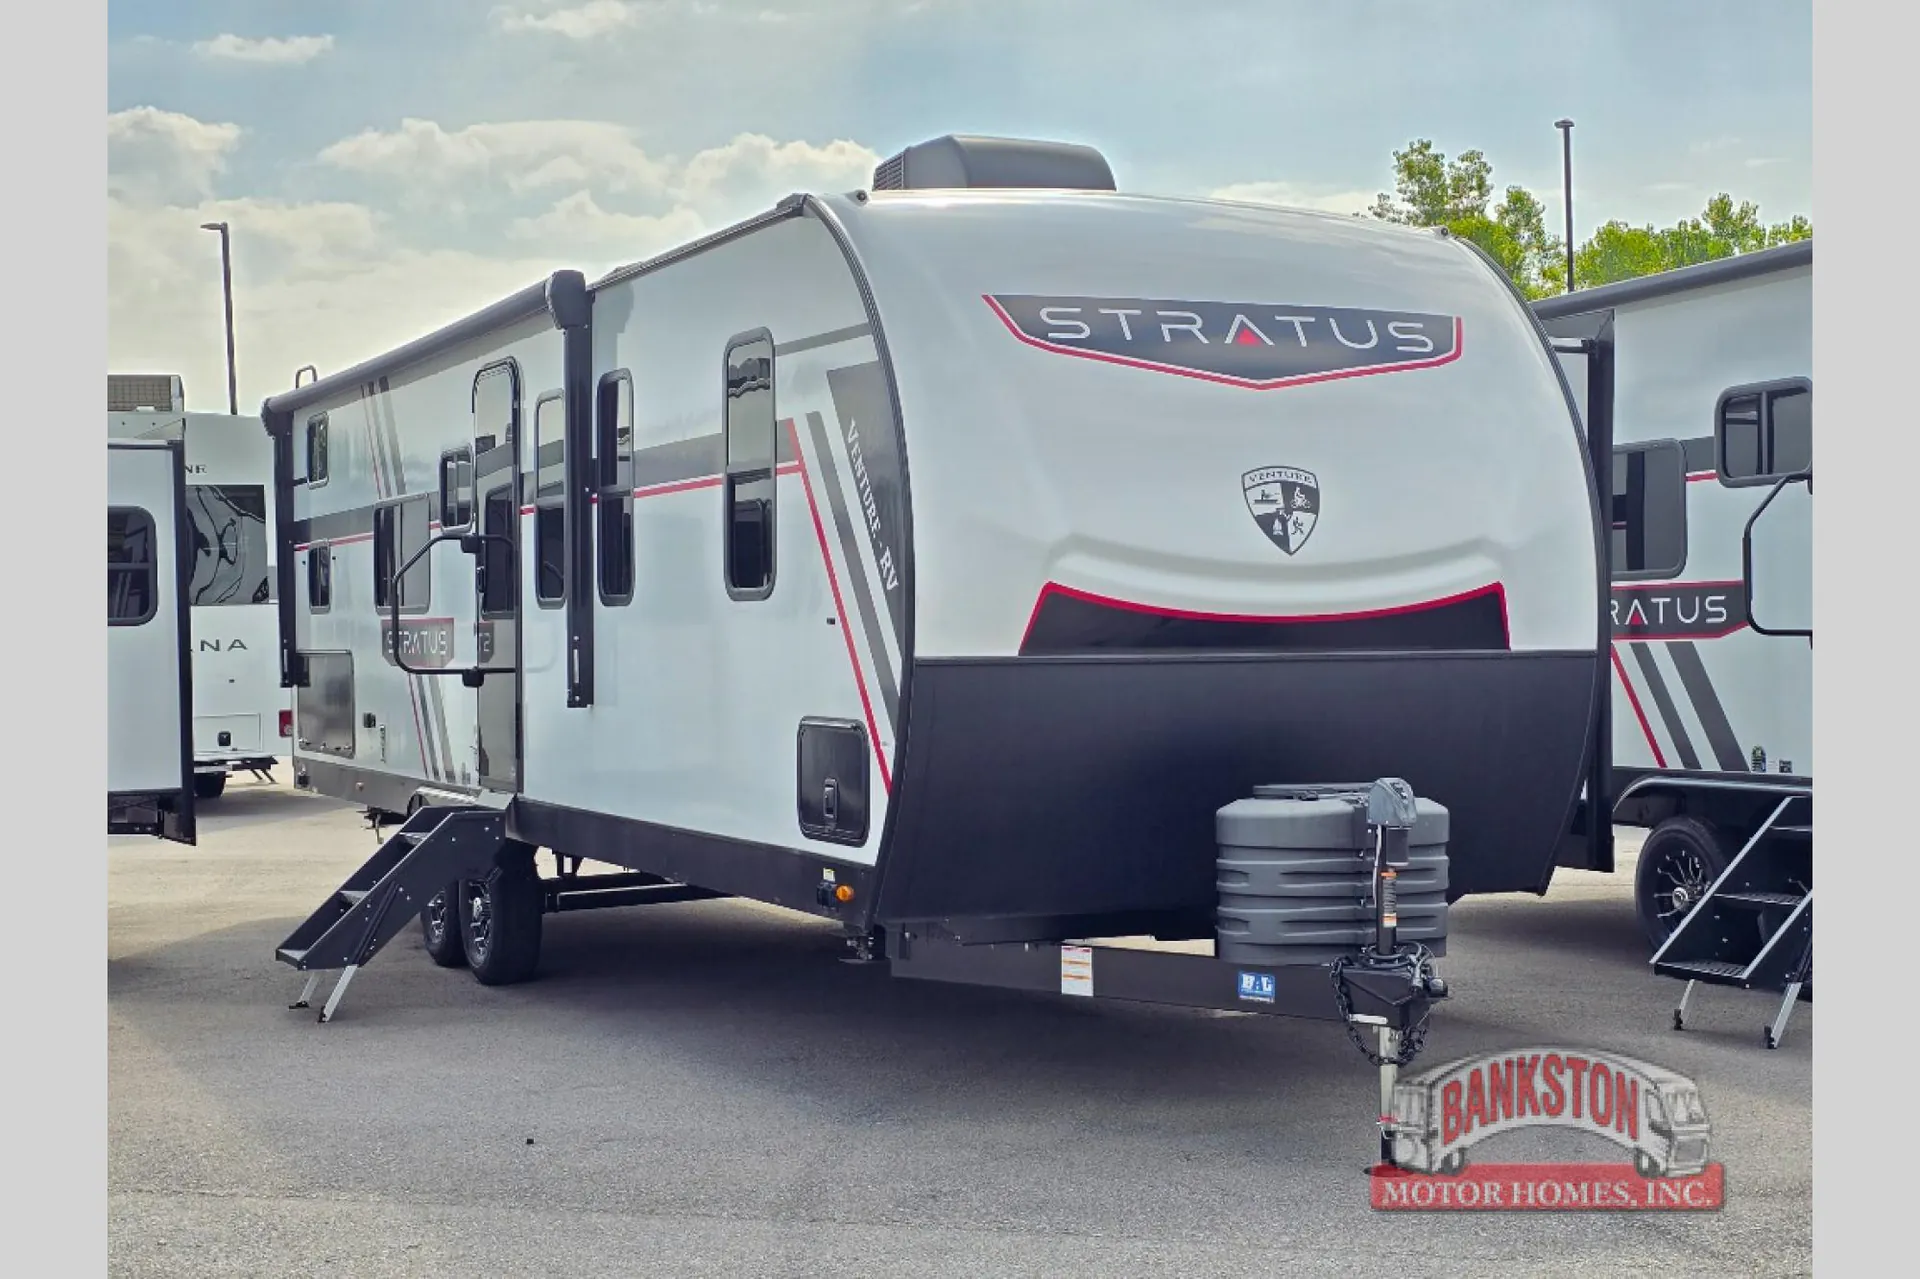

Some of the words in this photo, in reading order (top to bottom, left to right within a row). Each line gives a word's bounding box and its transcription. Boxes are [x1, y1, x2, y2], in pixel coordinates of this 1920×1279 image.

[1039, 307, 1434, 352] STRATUS
[1249, 471, 1313, 484] VENTURE
[847, 415, 881, 538] VENTURE
[880, 545, 899, 591] RV
